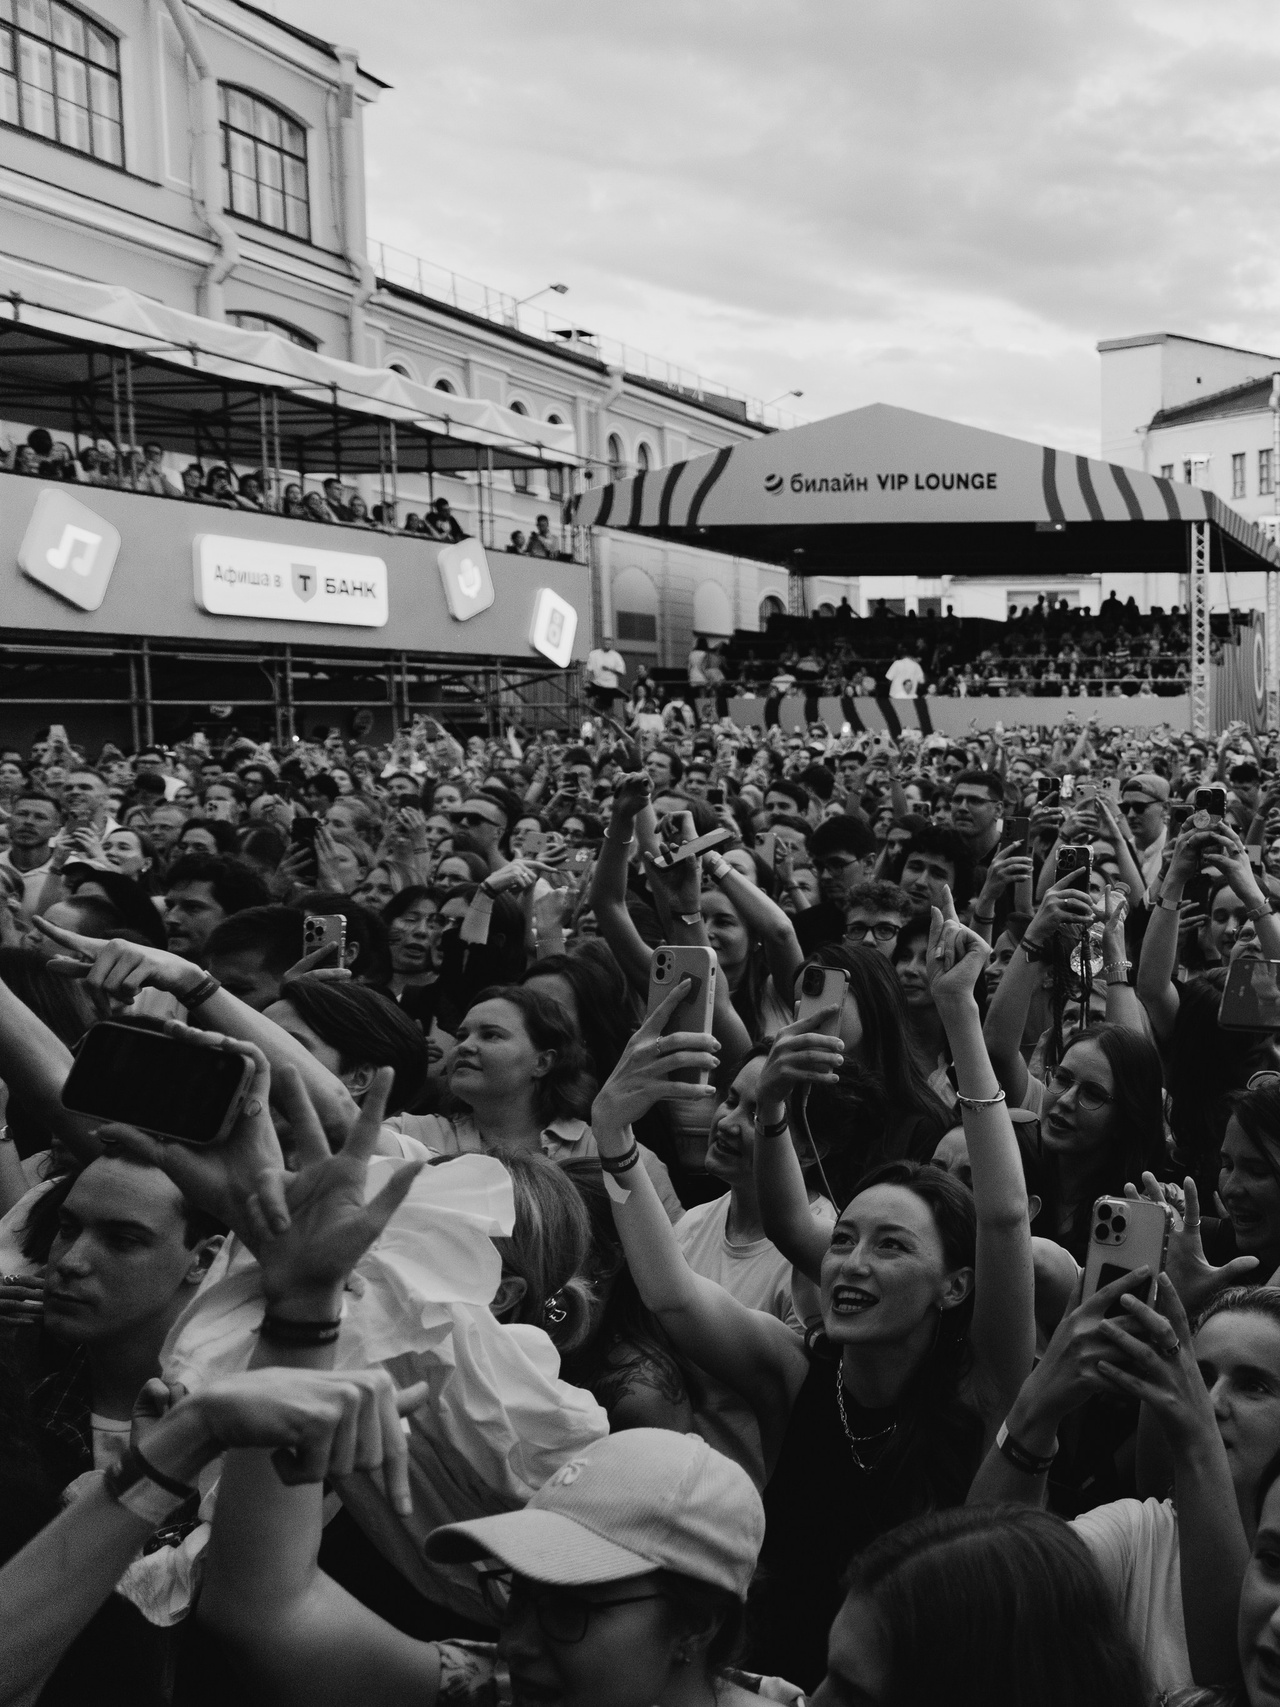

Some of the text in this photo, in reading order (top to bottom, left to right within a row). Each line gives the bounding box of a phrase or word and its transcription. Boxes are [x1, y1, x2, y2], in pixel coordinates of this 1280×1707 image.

[790, 473, 998, 493] билайн VIP LOUNGE
[214, 564, 270, 588] Афиша
[325, 578, 376, 599] БАНК
